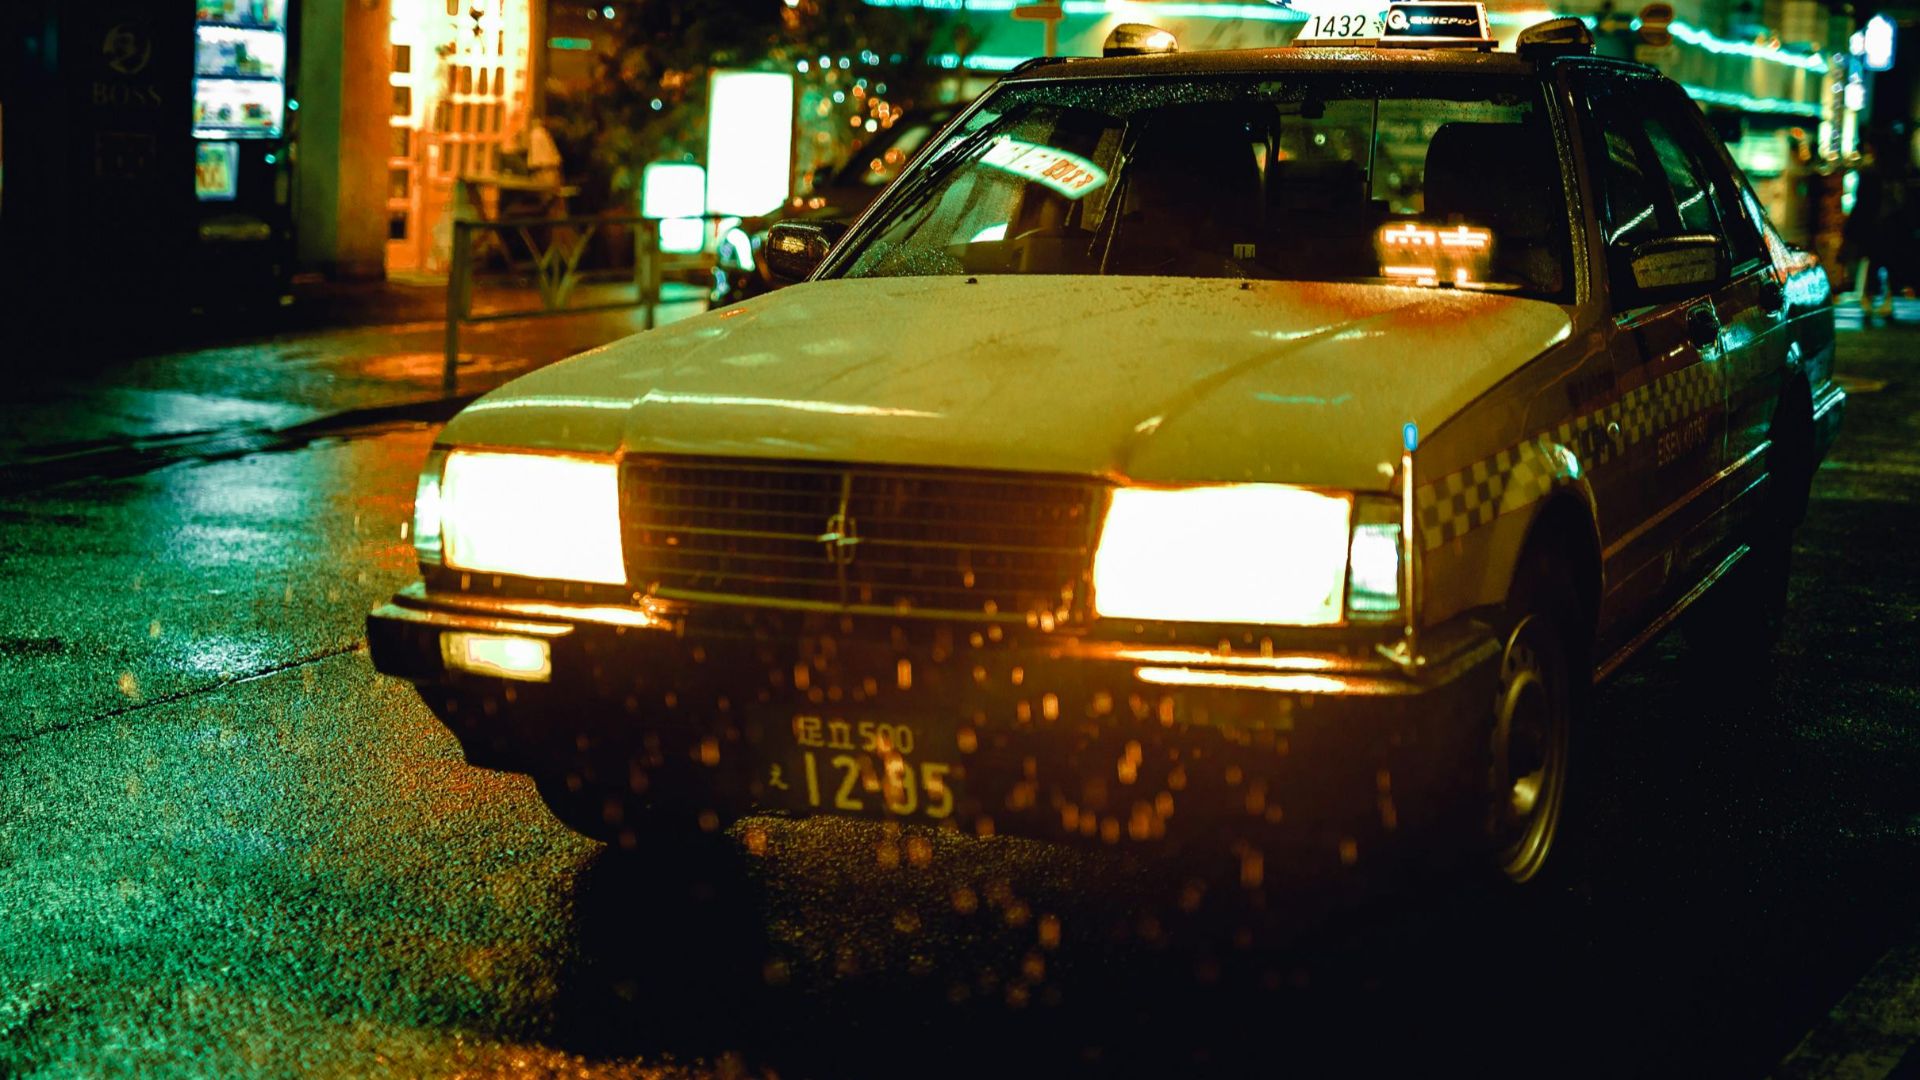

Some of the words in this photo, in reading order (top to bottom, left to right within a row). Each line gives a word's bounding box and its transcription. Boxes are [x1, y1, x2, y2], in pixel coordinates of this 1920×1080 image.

[1313, 15, 1367, 38] 1432
[92, 81, 163, 106] BOSS
[858, 720, 914, 755] 500
